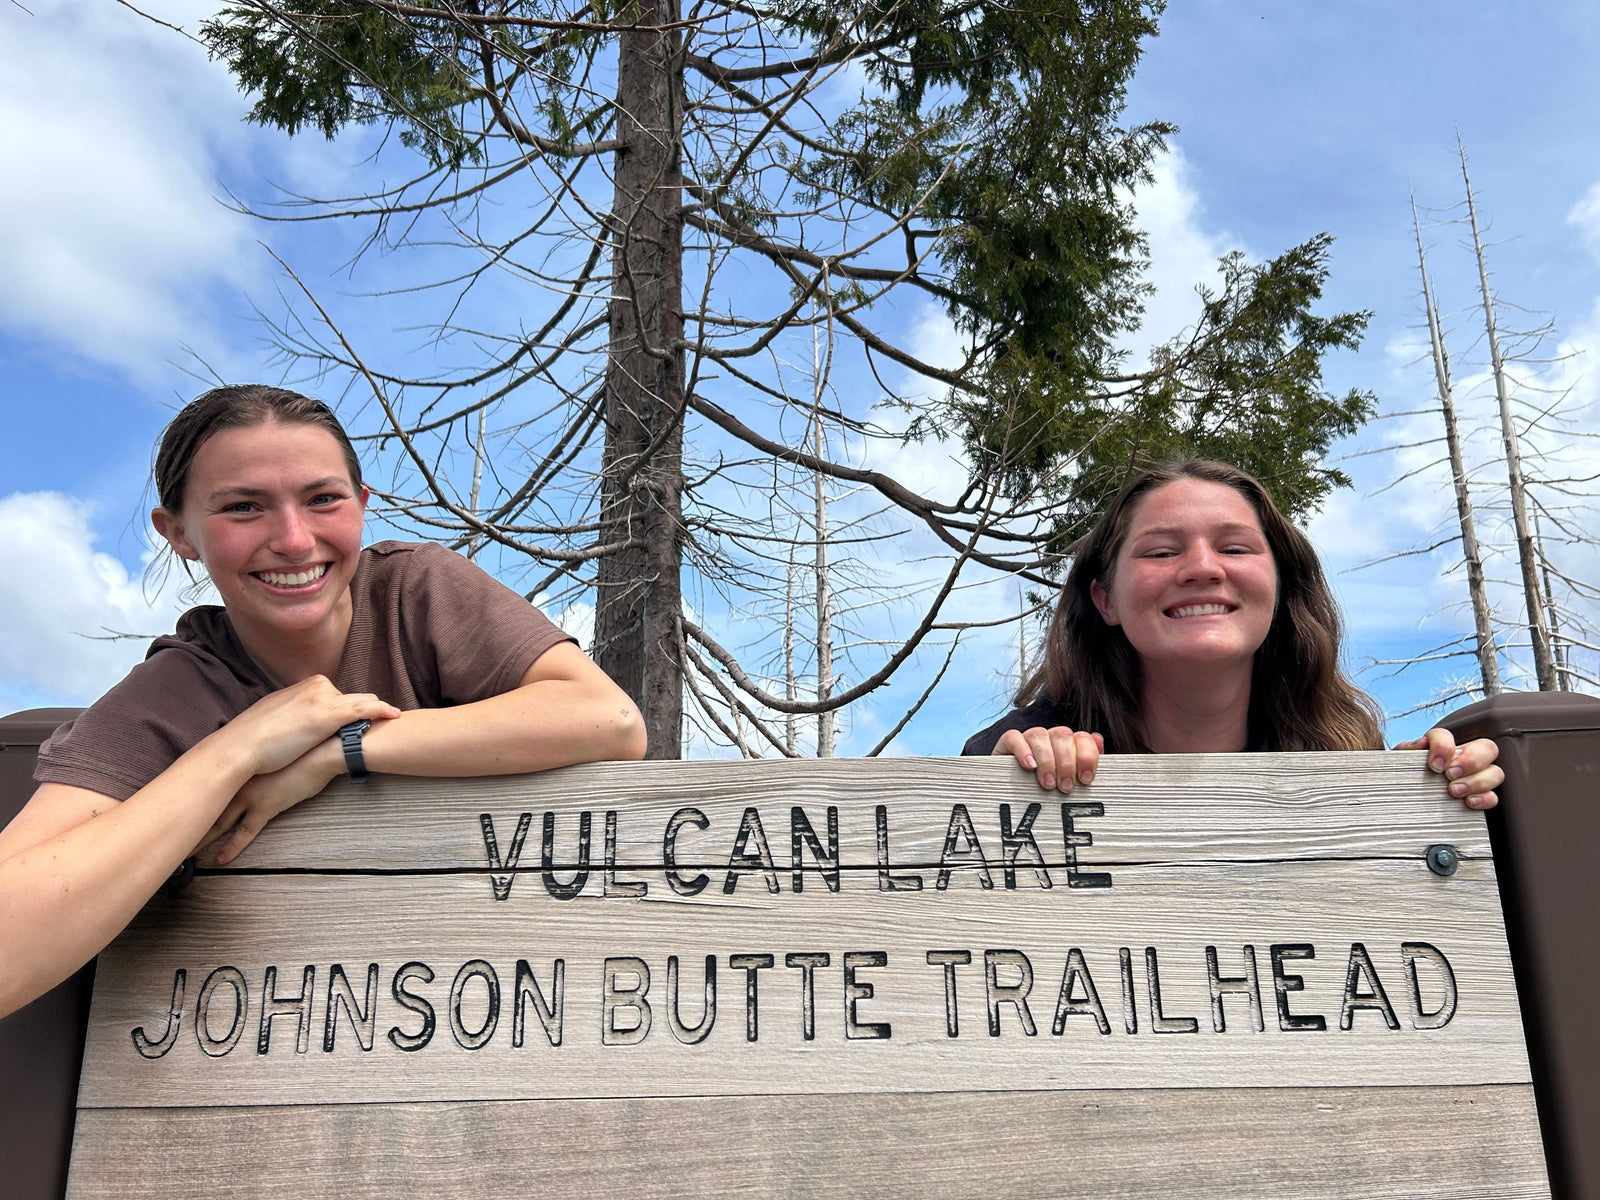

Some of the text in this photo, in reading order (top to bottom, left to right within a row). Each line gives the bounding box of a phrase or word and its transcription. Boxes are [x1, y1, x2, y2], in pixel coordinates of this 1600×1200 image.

[479, 802, 1113, 900] VULCAN LAKE
[131, 942, 1459, 1059] JOHNSON BUTTE TRAILHEAD
